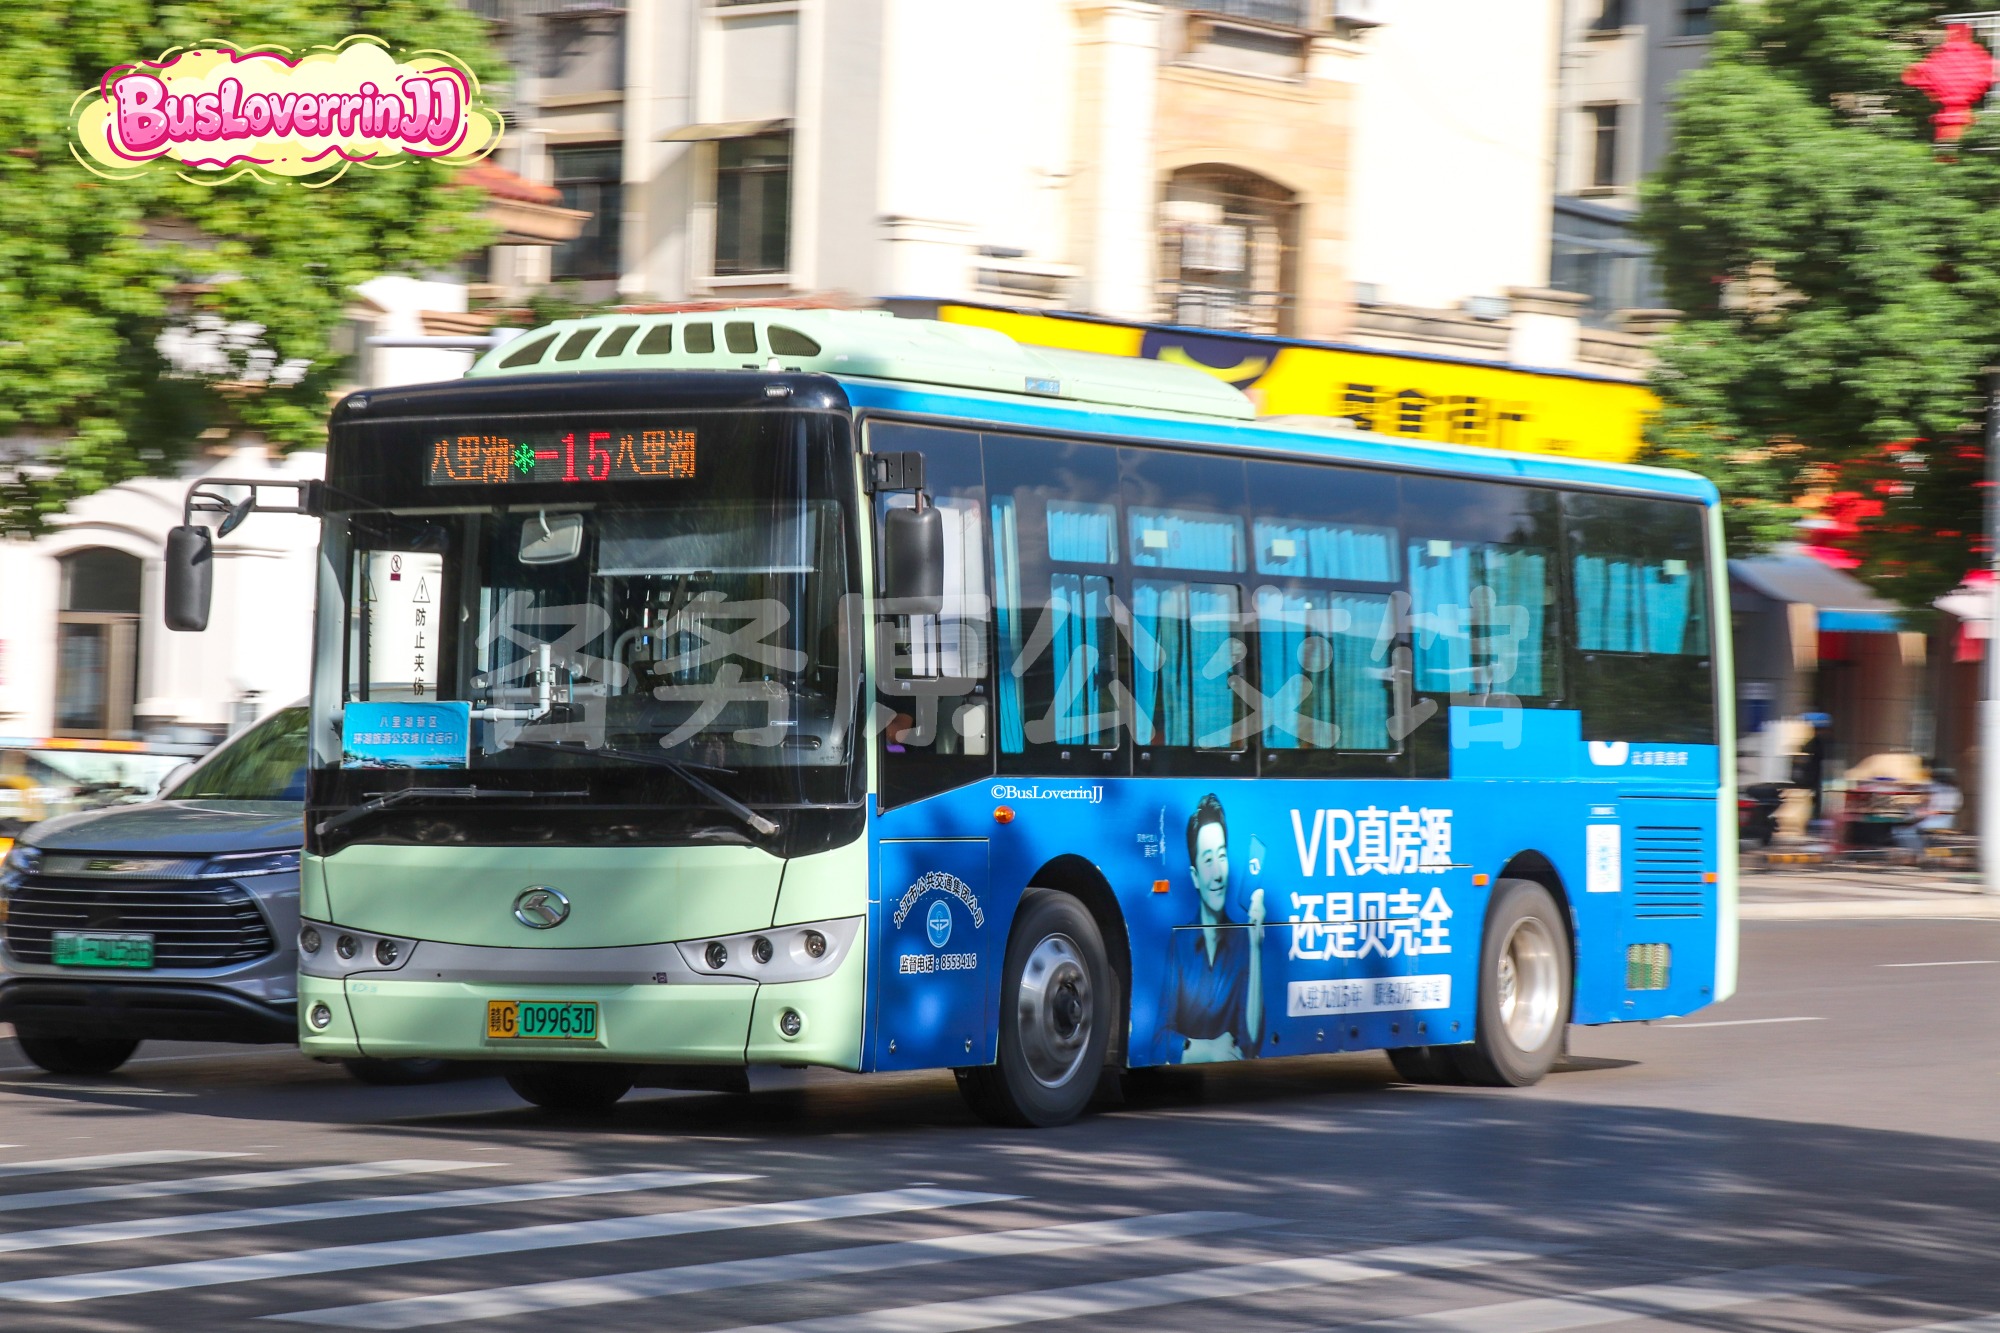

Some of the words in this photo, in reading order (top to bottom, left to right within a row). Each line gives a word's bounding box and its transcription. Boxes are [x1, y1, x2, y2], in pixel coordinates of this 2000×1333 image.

[413, 607, 426, 696] 防止夹伤
[380, 715, 438, 728] 八里湖新区
[1290, 805, 1453, 877] VR真房源
[893, 871, 985, 930] 九江市公共交通集团公司
[1288, 886, 1453, 961] 还是贝壳全
